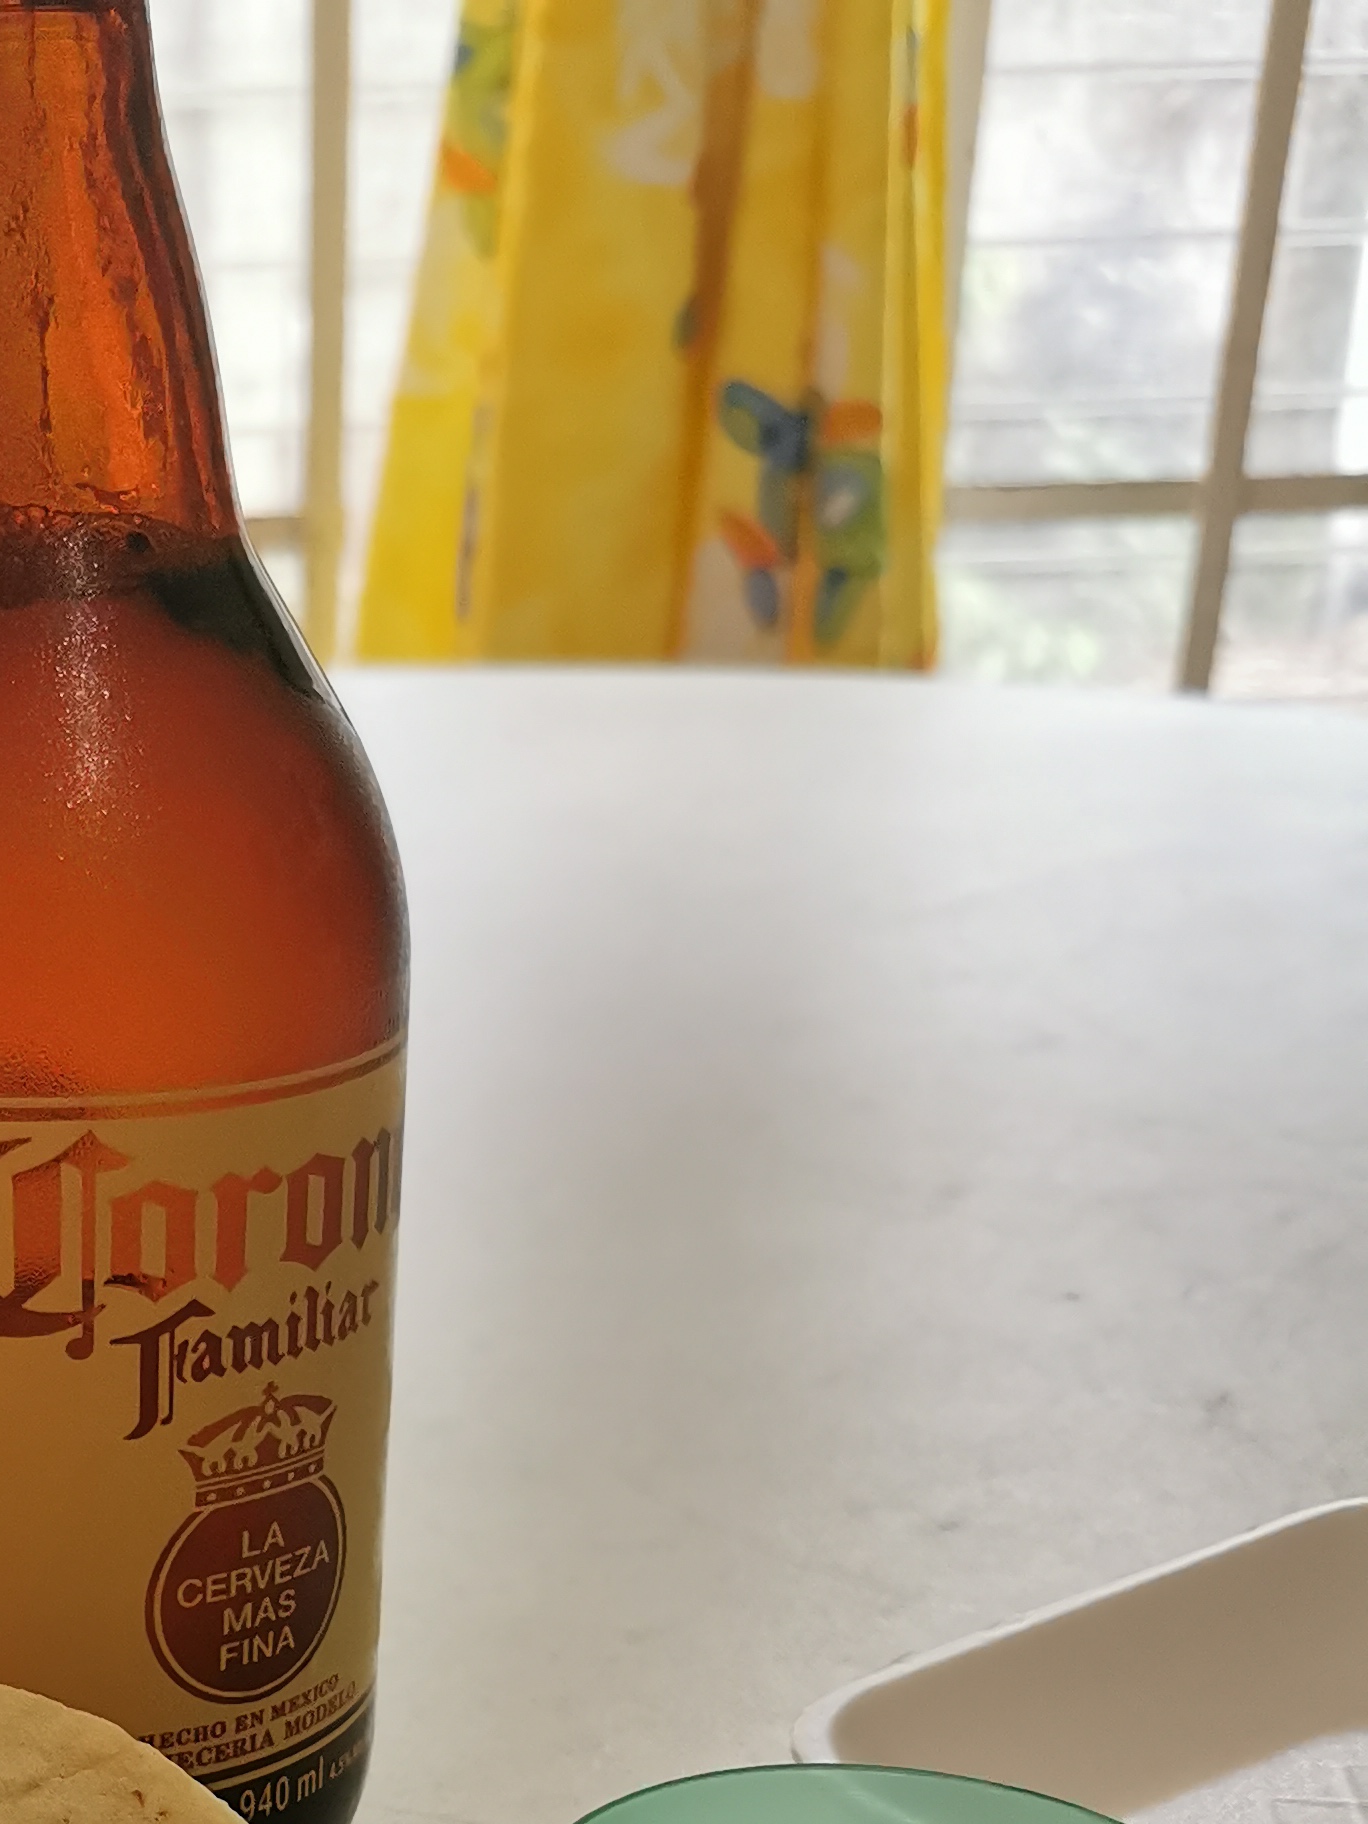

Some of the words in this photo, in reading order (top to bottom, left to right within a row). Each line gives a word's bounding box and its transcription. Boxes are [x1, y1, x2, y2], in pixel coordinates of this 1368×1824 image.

[109, 1280, 379, 1440] Familiar
[241, 1521, 284, 1558] LA
[177, 1539, 330, 1608] CERVEZA
[223, 1589, 297, 1636] MAS
[219, 1625, 296, 1671] FINA
[137, 1721, 227, 1749] HECHO
[235, 1708, 265, 1735] EN
[270, 1673, 339, 1722] MEXICO
[164, 1728, 275, 1770] ECERIA
[284, 1681, 356, 1741] MODELO
[239, 1775, 290, 1821] 940
[296, 1755, 324, 1802] ml
